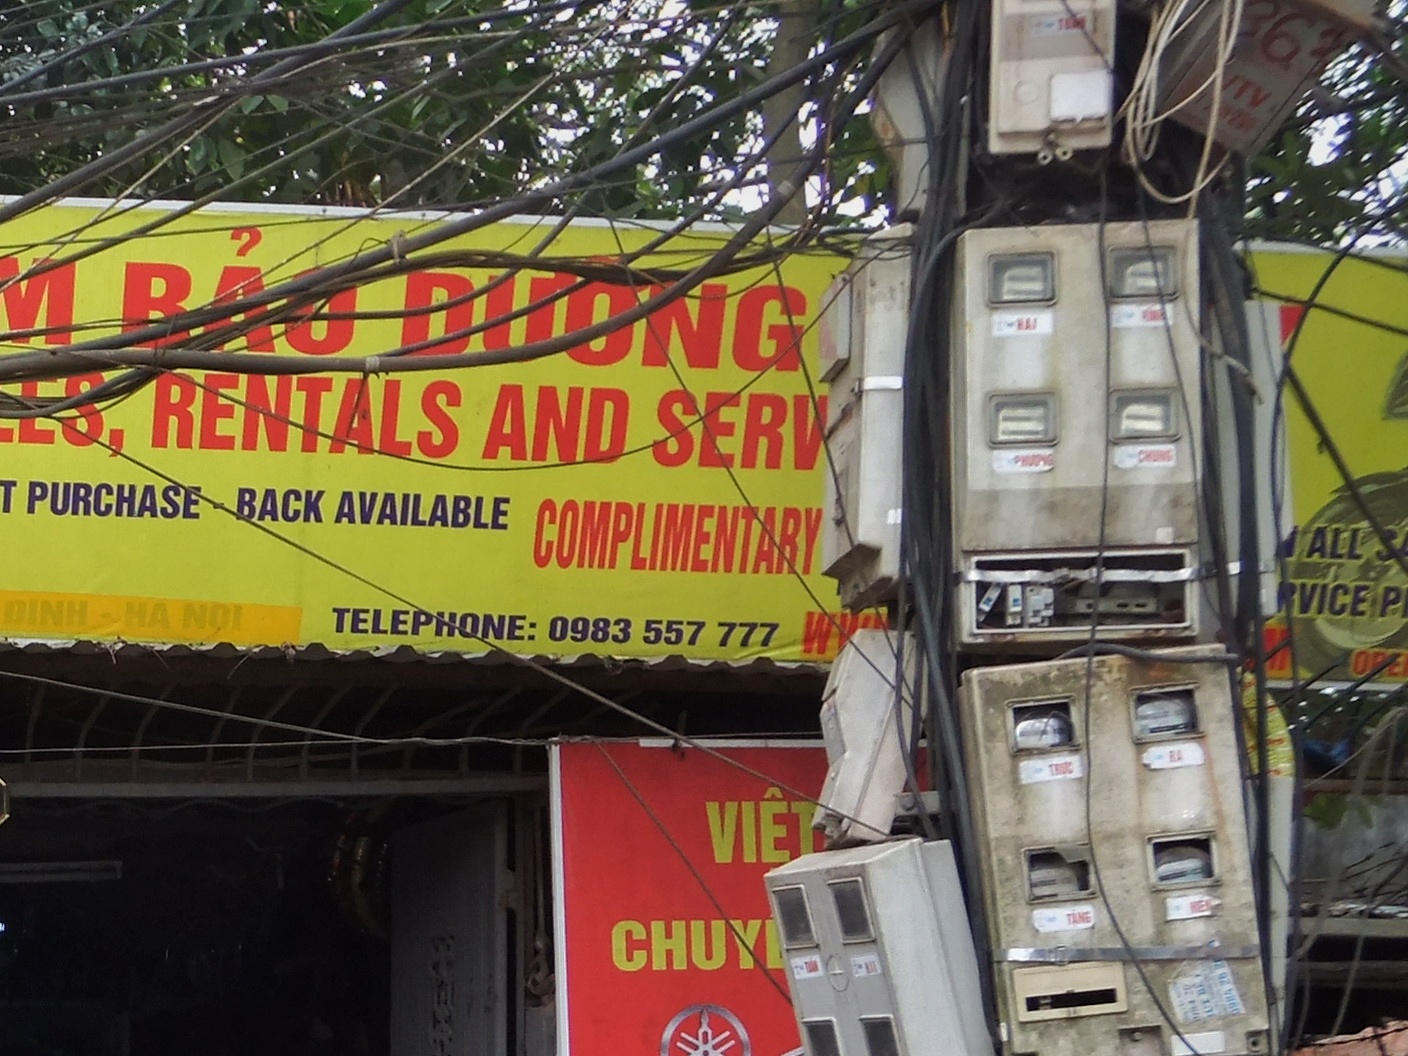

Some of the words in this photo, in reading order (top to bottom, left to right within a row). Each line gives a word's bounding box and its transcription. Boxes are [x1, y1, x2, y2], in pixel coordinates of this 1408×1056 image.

[151, 371, 462, 462] RENTALS
[482, 383, 632, 465] AND
[26, 480, 202, 522] PURCHASE
[236, 487, 324, 525] BACK
[334, 491, 511, 532] AVAILABLE
[534, 498, 823, 576] COMPLIMENTARY
[332, 607, 537, 643] TELEPHONE:
[548, 615, 633, 646] 0983
[643, 618, 707, 648] 557
[717, 621, 779, 650] 777
